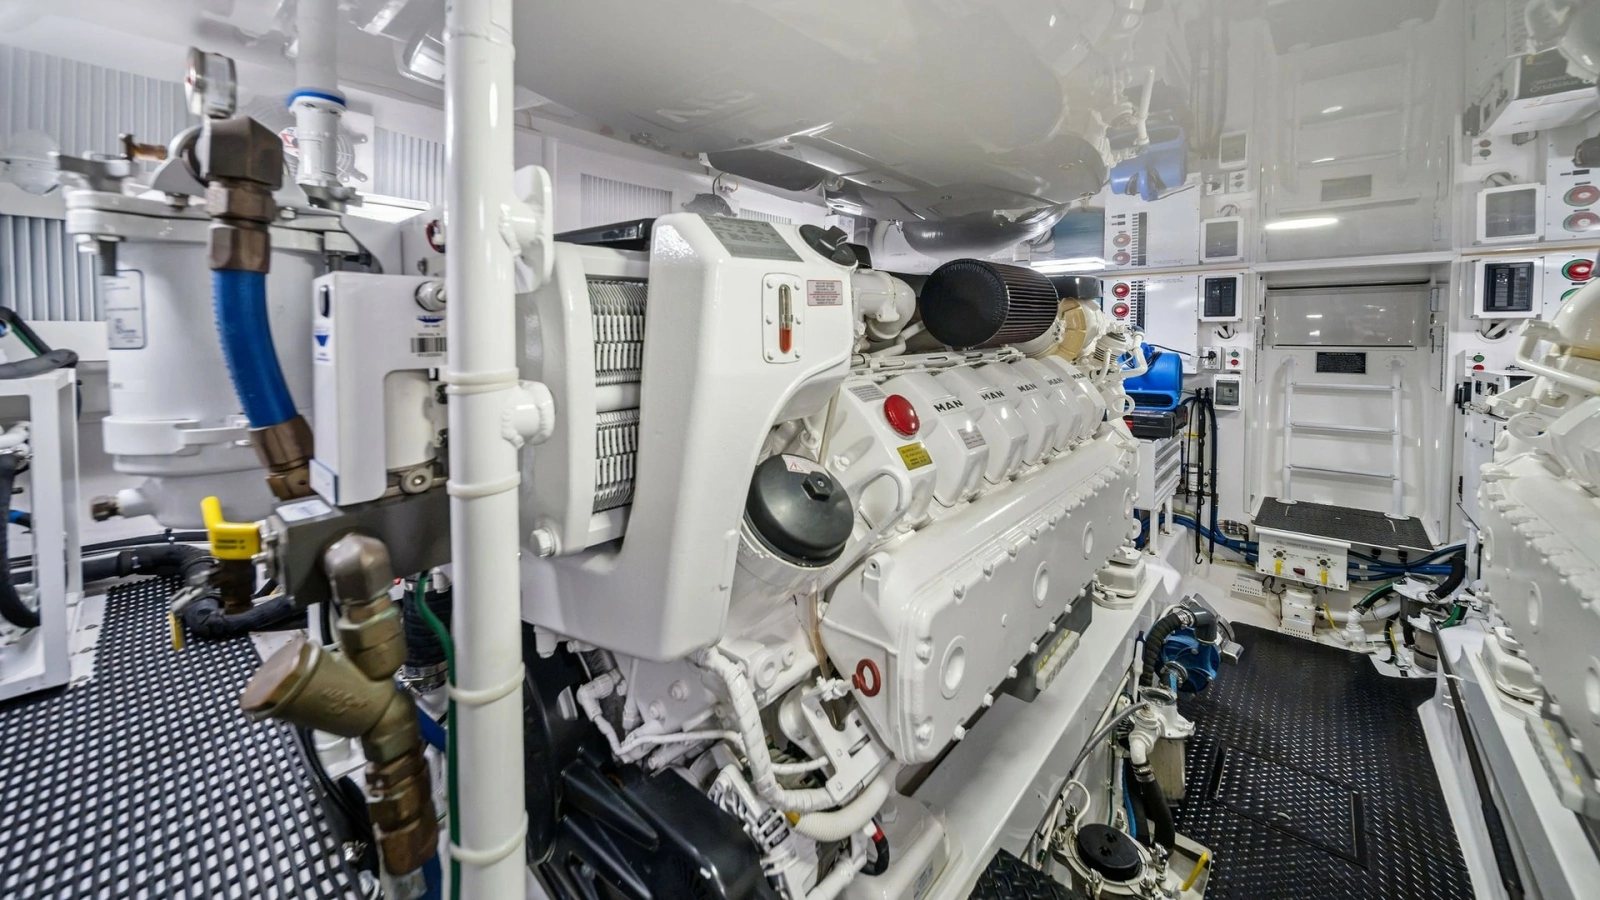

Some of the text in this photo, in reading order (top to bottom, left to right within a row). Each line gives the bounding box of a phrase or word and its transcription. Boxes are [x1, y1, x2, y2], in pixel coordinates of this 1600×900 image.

[1048, 377, 1064, 385] MAN
[1017, 383, 1038, 393] MAN
[981, 391, 1005, 401] MAN
[933, 400, 964, 413] MAN
